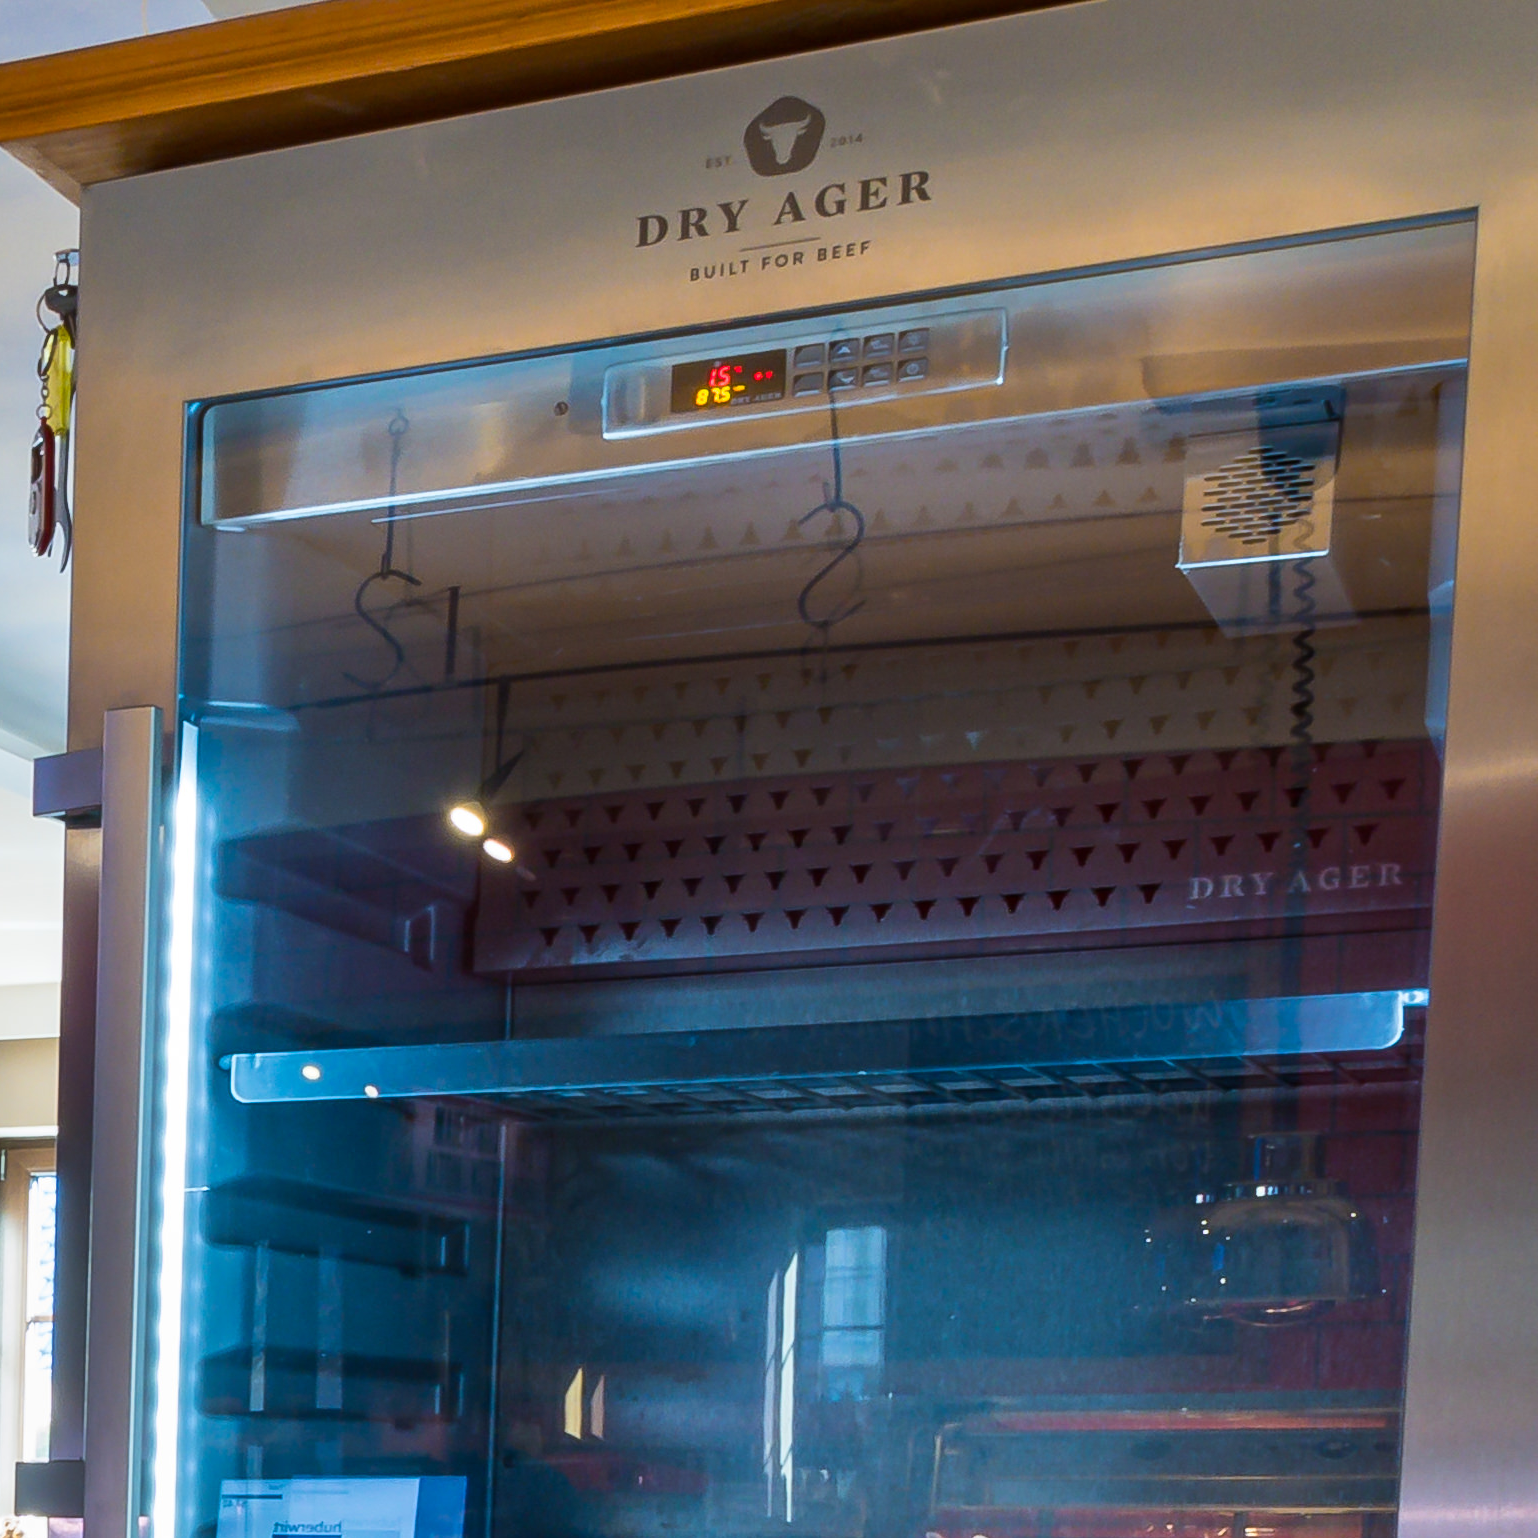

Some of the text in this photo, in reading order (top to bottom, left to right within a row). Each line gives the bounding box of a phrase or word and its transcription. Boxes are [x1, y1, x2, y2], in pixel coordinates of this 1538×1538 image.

[830, 133, 864, 148] 2014
[635, 170, 932, 248] DRY AGER
[690, 240, 872, 282] BUILT FOR BEEF
[1189, 863, 1403, 900] DRY AGER
